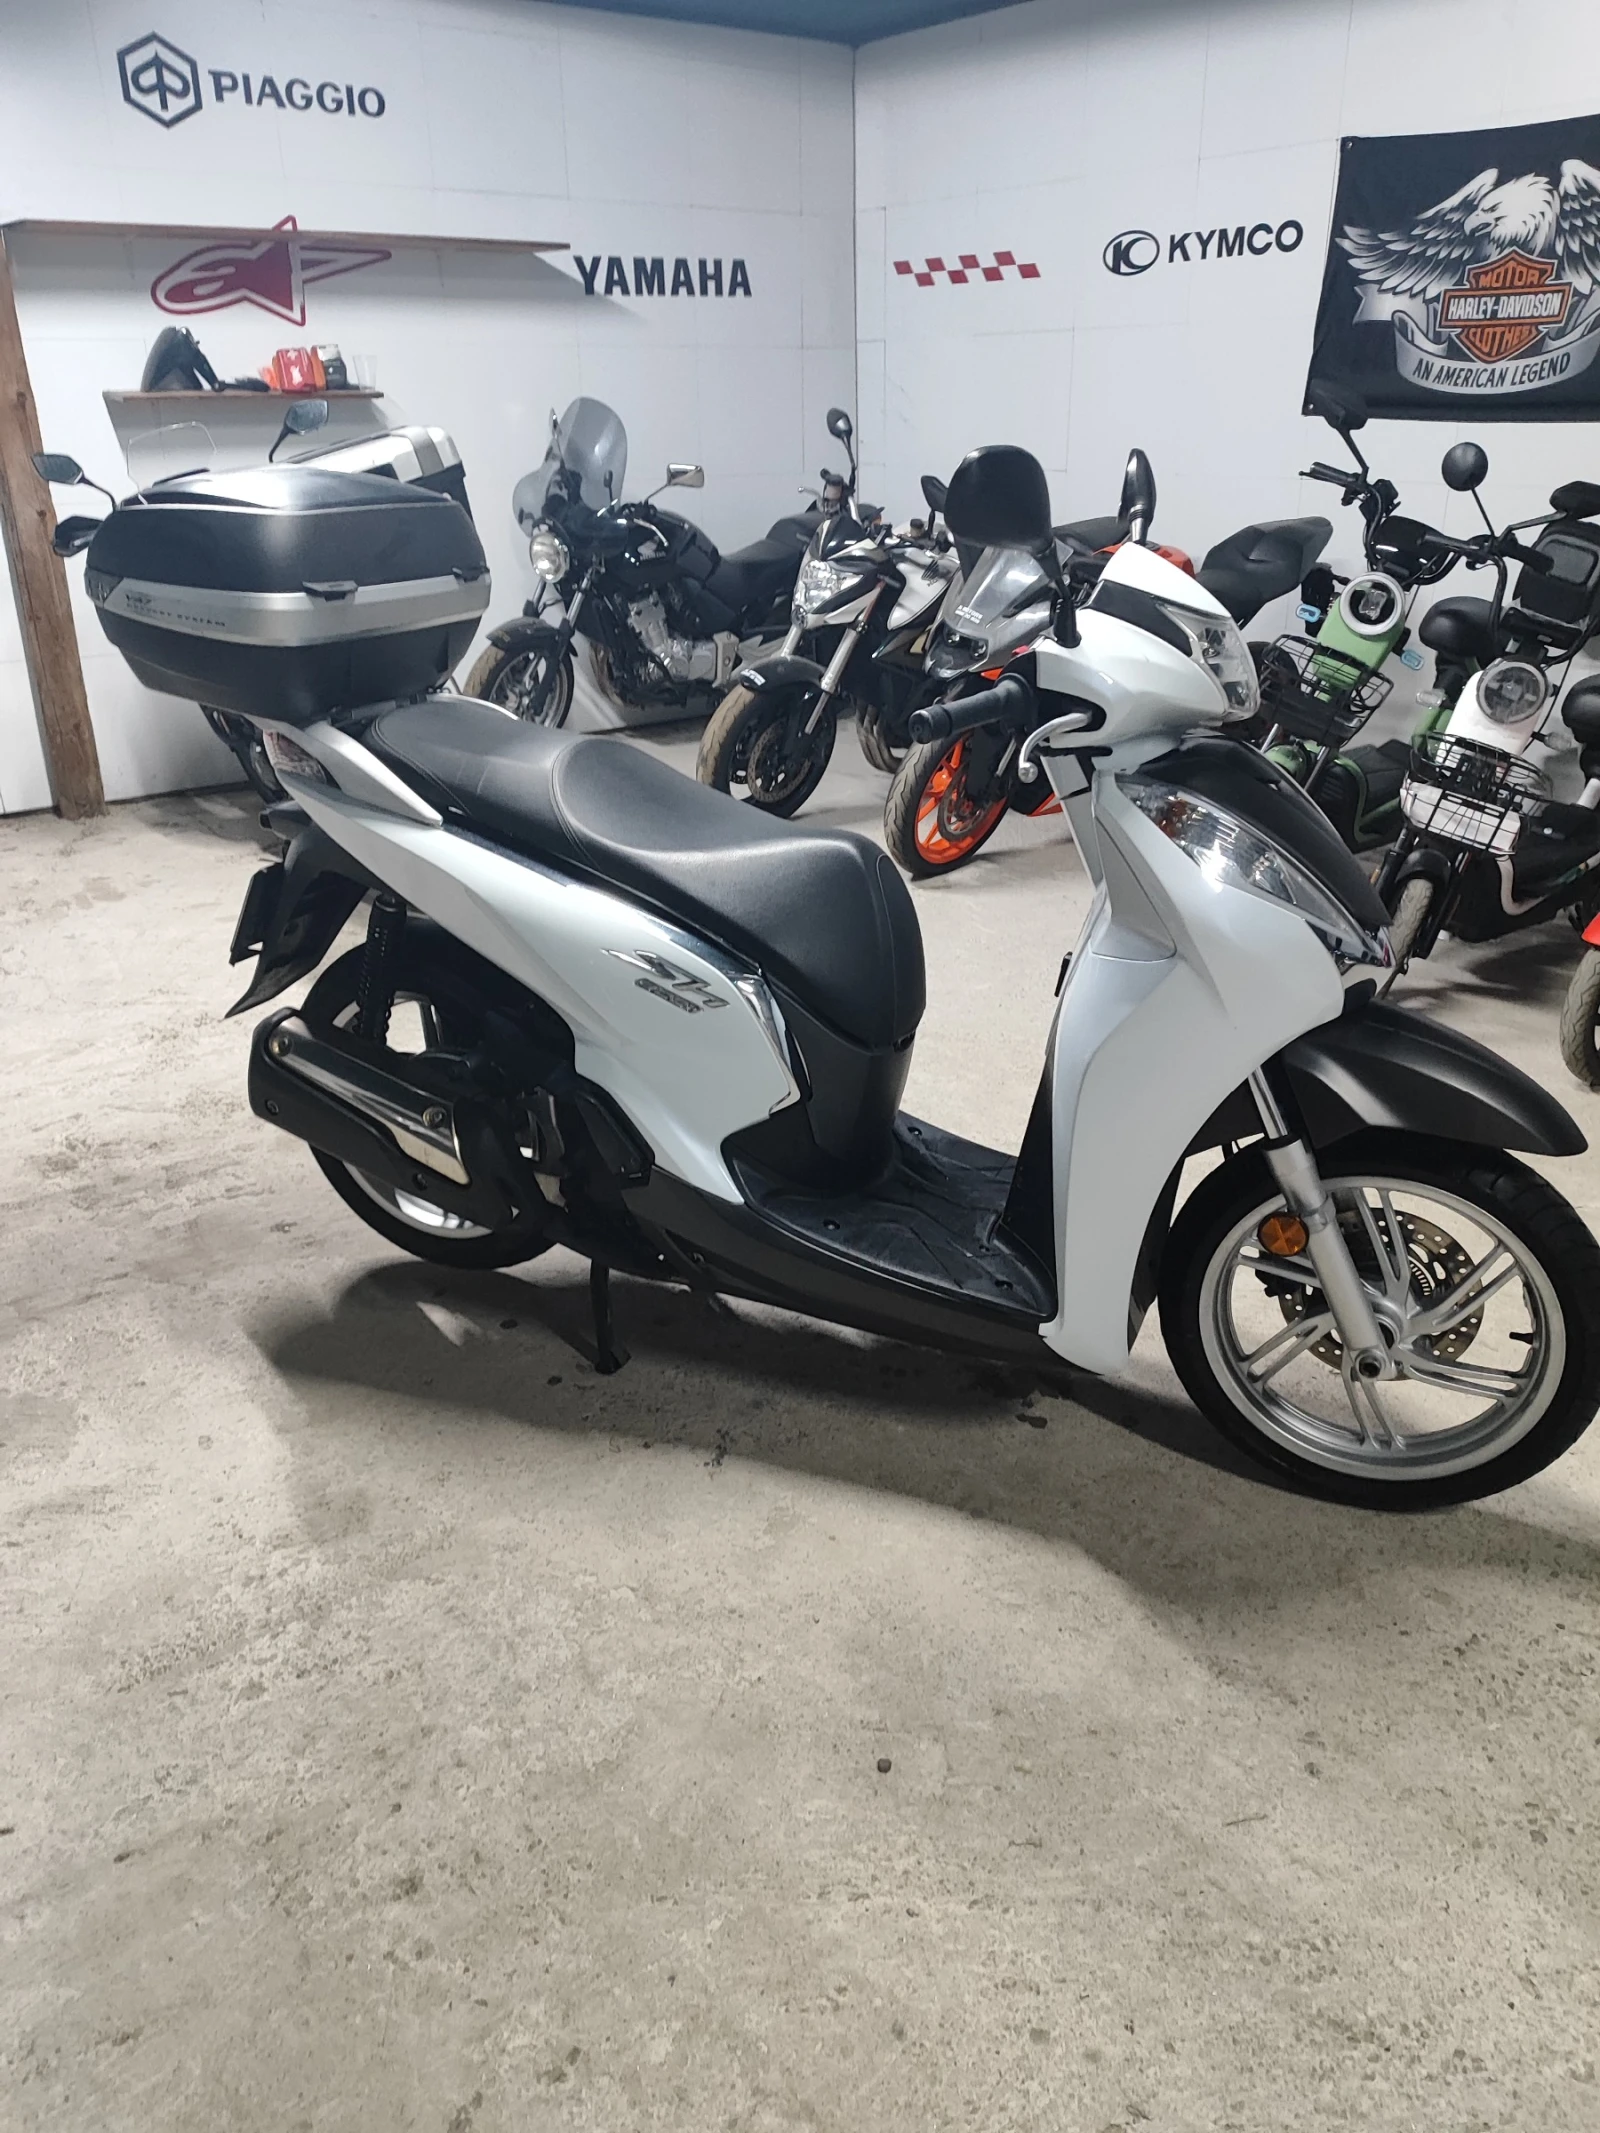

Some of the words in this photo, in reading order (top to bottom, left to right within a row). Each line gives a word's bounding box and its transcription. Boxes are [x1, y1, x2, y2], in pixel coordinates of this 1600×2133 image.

[208, 69, 385, 117] PIAGGIO
[1168, 220, 1304, 263] KYMCO
[573, 255, 752, 297] YAMAHA
[1479, 260, 1540, 288] MOTOR
[1448, 292, 1563, 320] HARLEY-DAVIDSON
[1412, 358, 1435, 382] AN
[1432, 364, 1510, 388] AMERICAN
[1510, 352, 1571, 387] LEGEND
